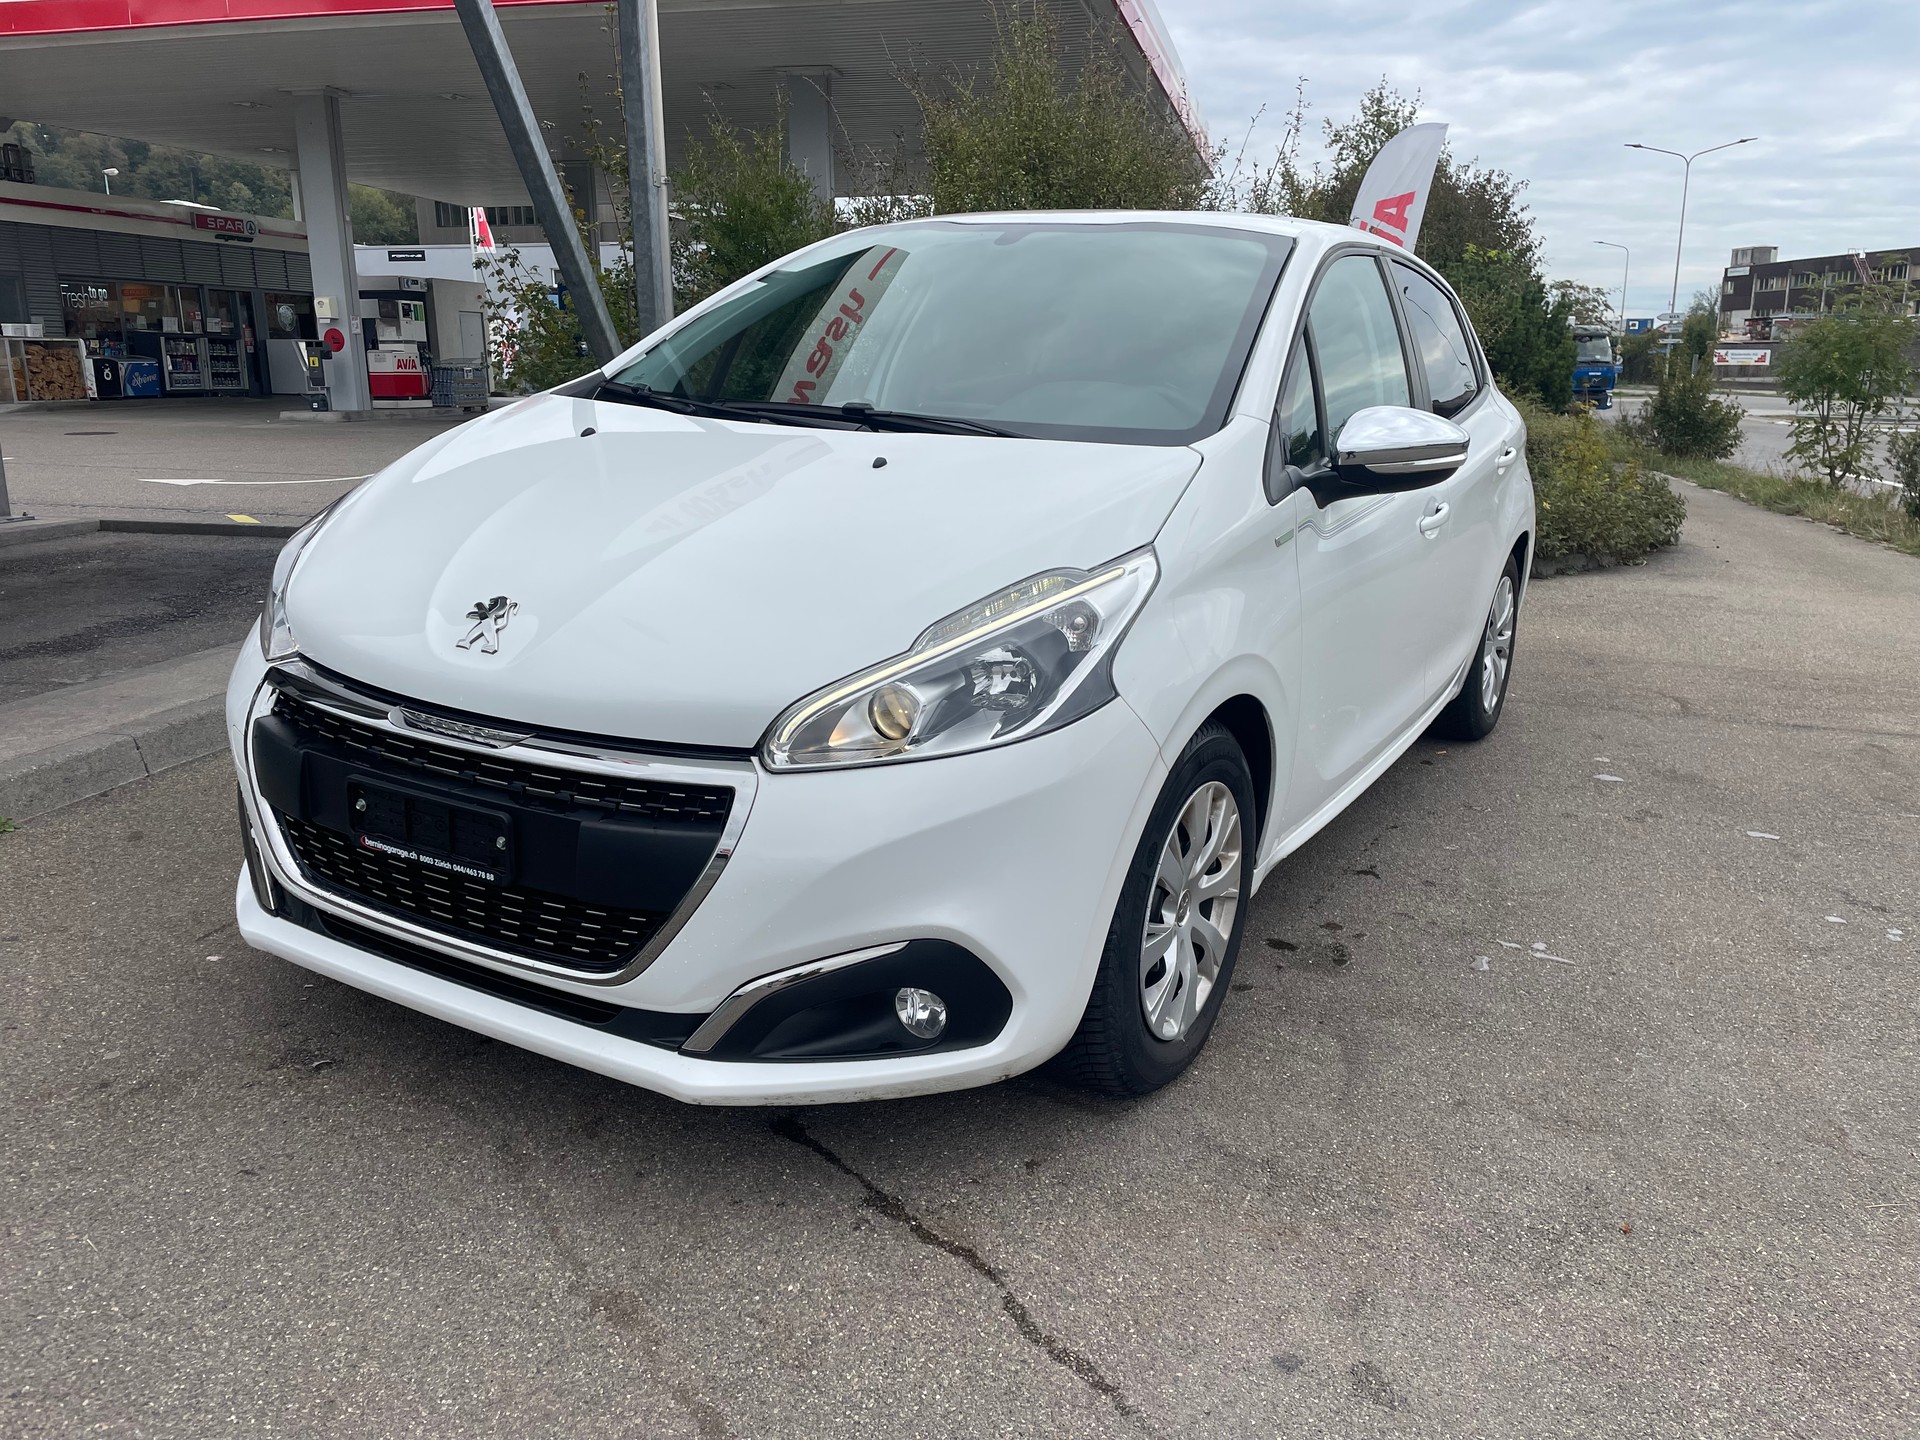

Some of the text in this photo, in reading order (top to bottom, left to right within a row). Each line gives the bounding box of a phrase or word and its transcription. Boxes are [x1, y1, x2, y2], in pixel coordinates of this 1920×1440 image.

[206, 217, 244, 232] SPAR
[60, 284, 90, 309] Fresh
[88, 286, 97, 299] to
[97, 288, 108, 302] go
[364, 836, 495, 881] berninagarage.ch 8003 Zürich 044/463 78 88
